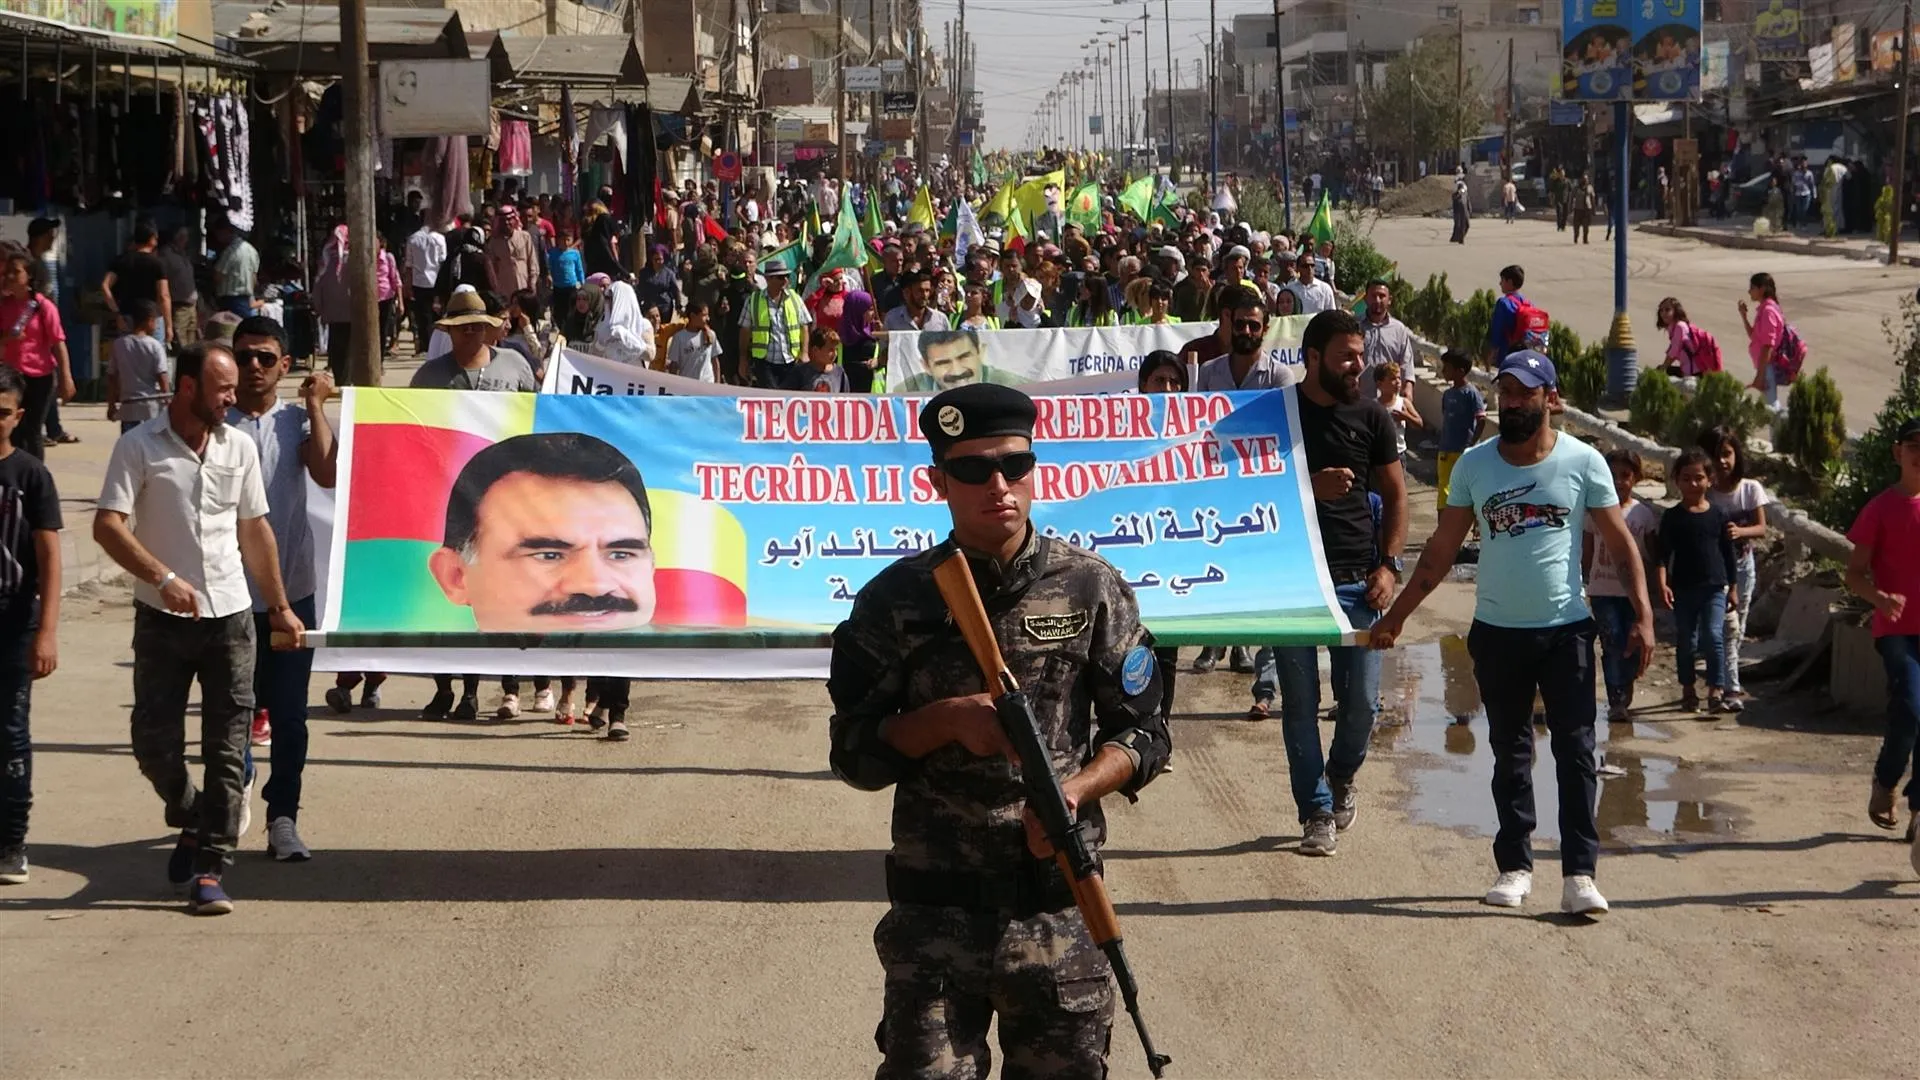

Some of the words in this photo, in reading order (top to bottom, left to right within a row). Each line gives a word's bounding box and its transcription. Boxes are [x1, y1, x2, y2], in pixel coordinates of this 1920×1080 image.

[1032, 397, 1154, 440] REBER
[1165, 396, 1233, 436] APO
[696, 455, 856, 502] TECRÎDA
[866, 467, 900, 502] LI
[1232, 437, 1283, 474] YE
[1159, 504, 1277, 543] العزلة
[762, 529, 811, 565] آبو
[1170, 566, 1225, 594] هي
